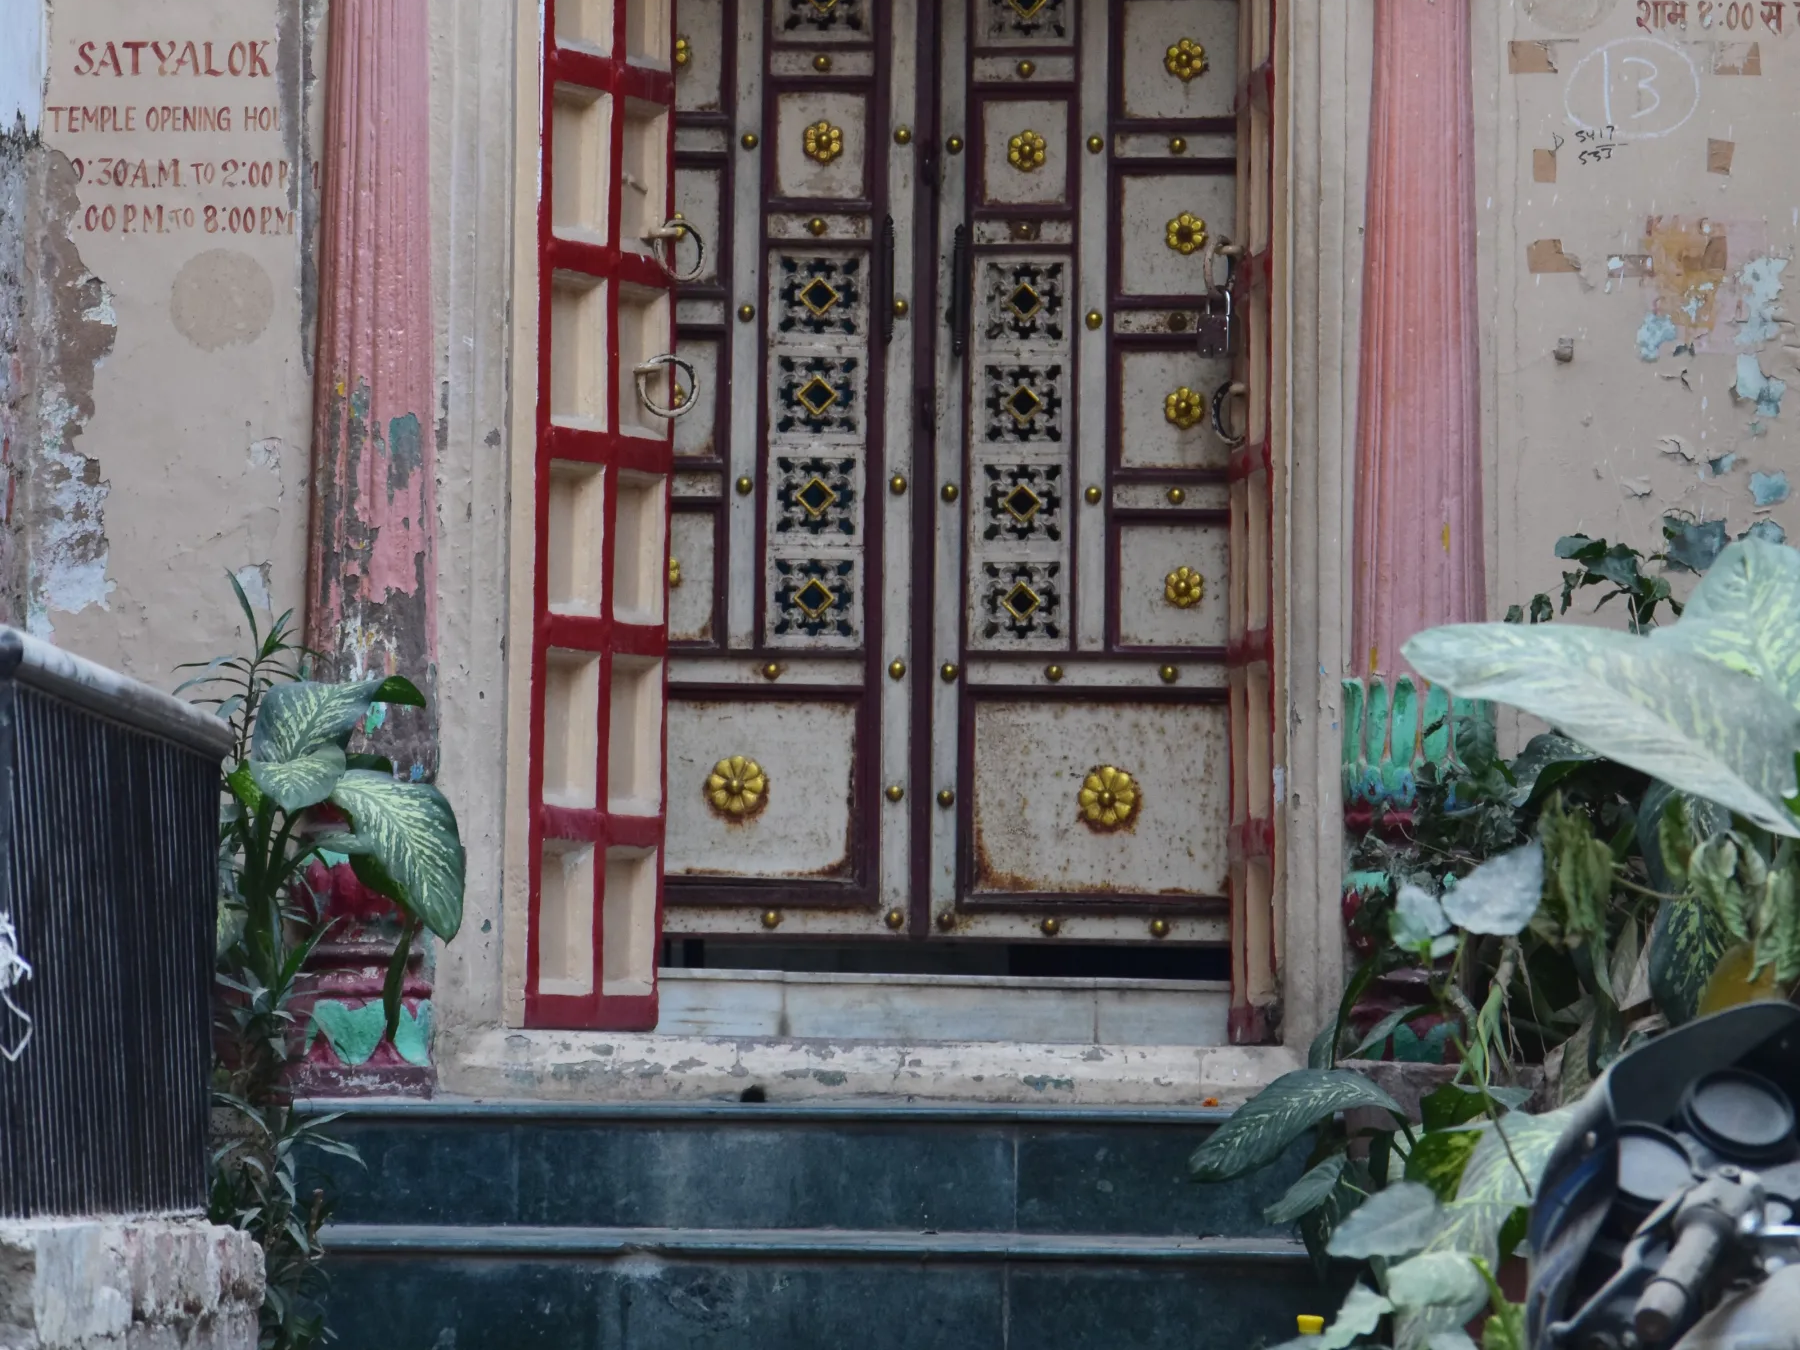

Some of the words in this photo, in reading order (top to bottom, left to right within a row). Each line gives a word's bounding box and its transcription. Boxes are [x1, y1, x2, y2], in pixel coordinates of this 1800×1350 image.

[47, 105, 137, 133] TEMPLE
[145, 106, 231, 133] OPENING
[190, 162, 215, 185] TO
[221, 158, 273, 188] 2:00
[169, 207, 194, 230] TO
[203, 204, 256, 234] 8:00
